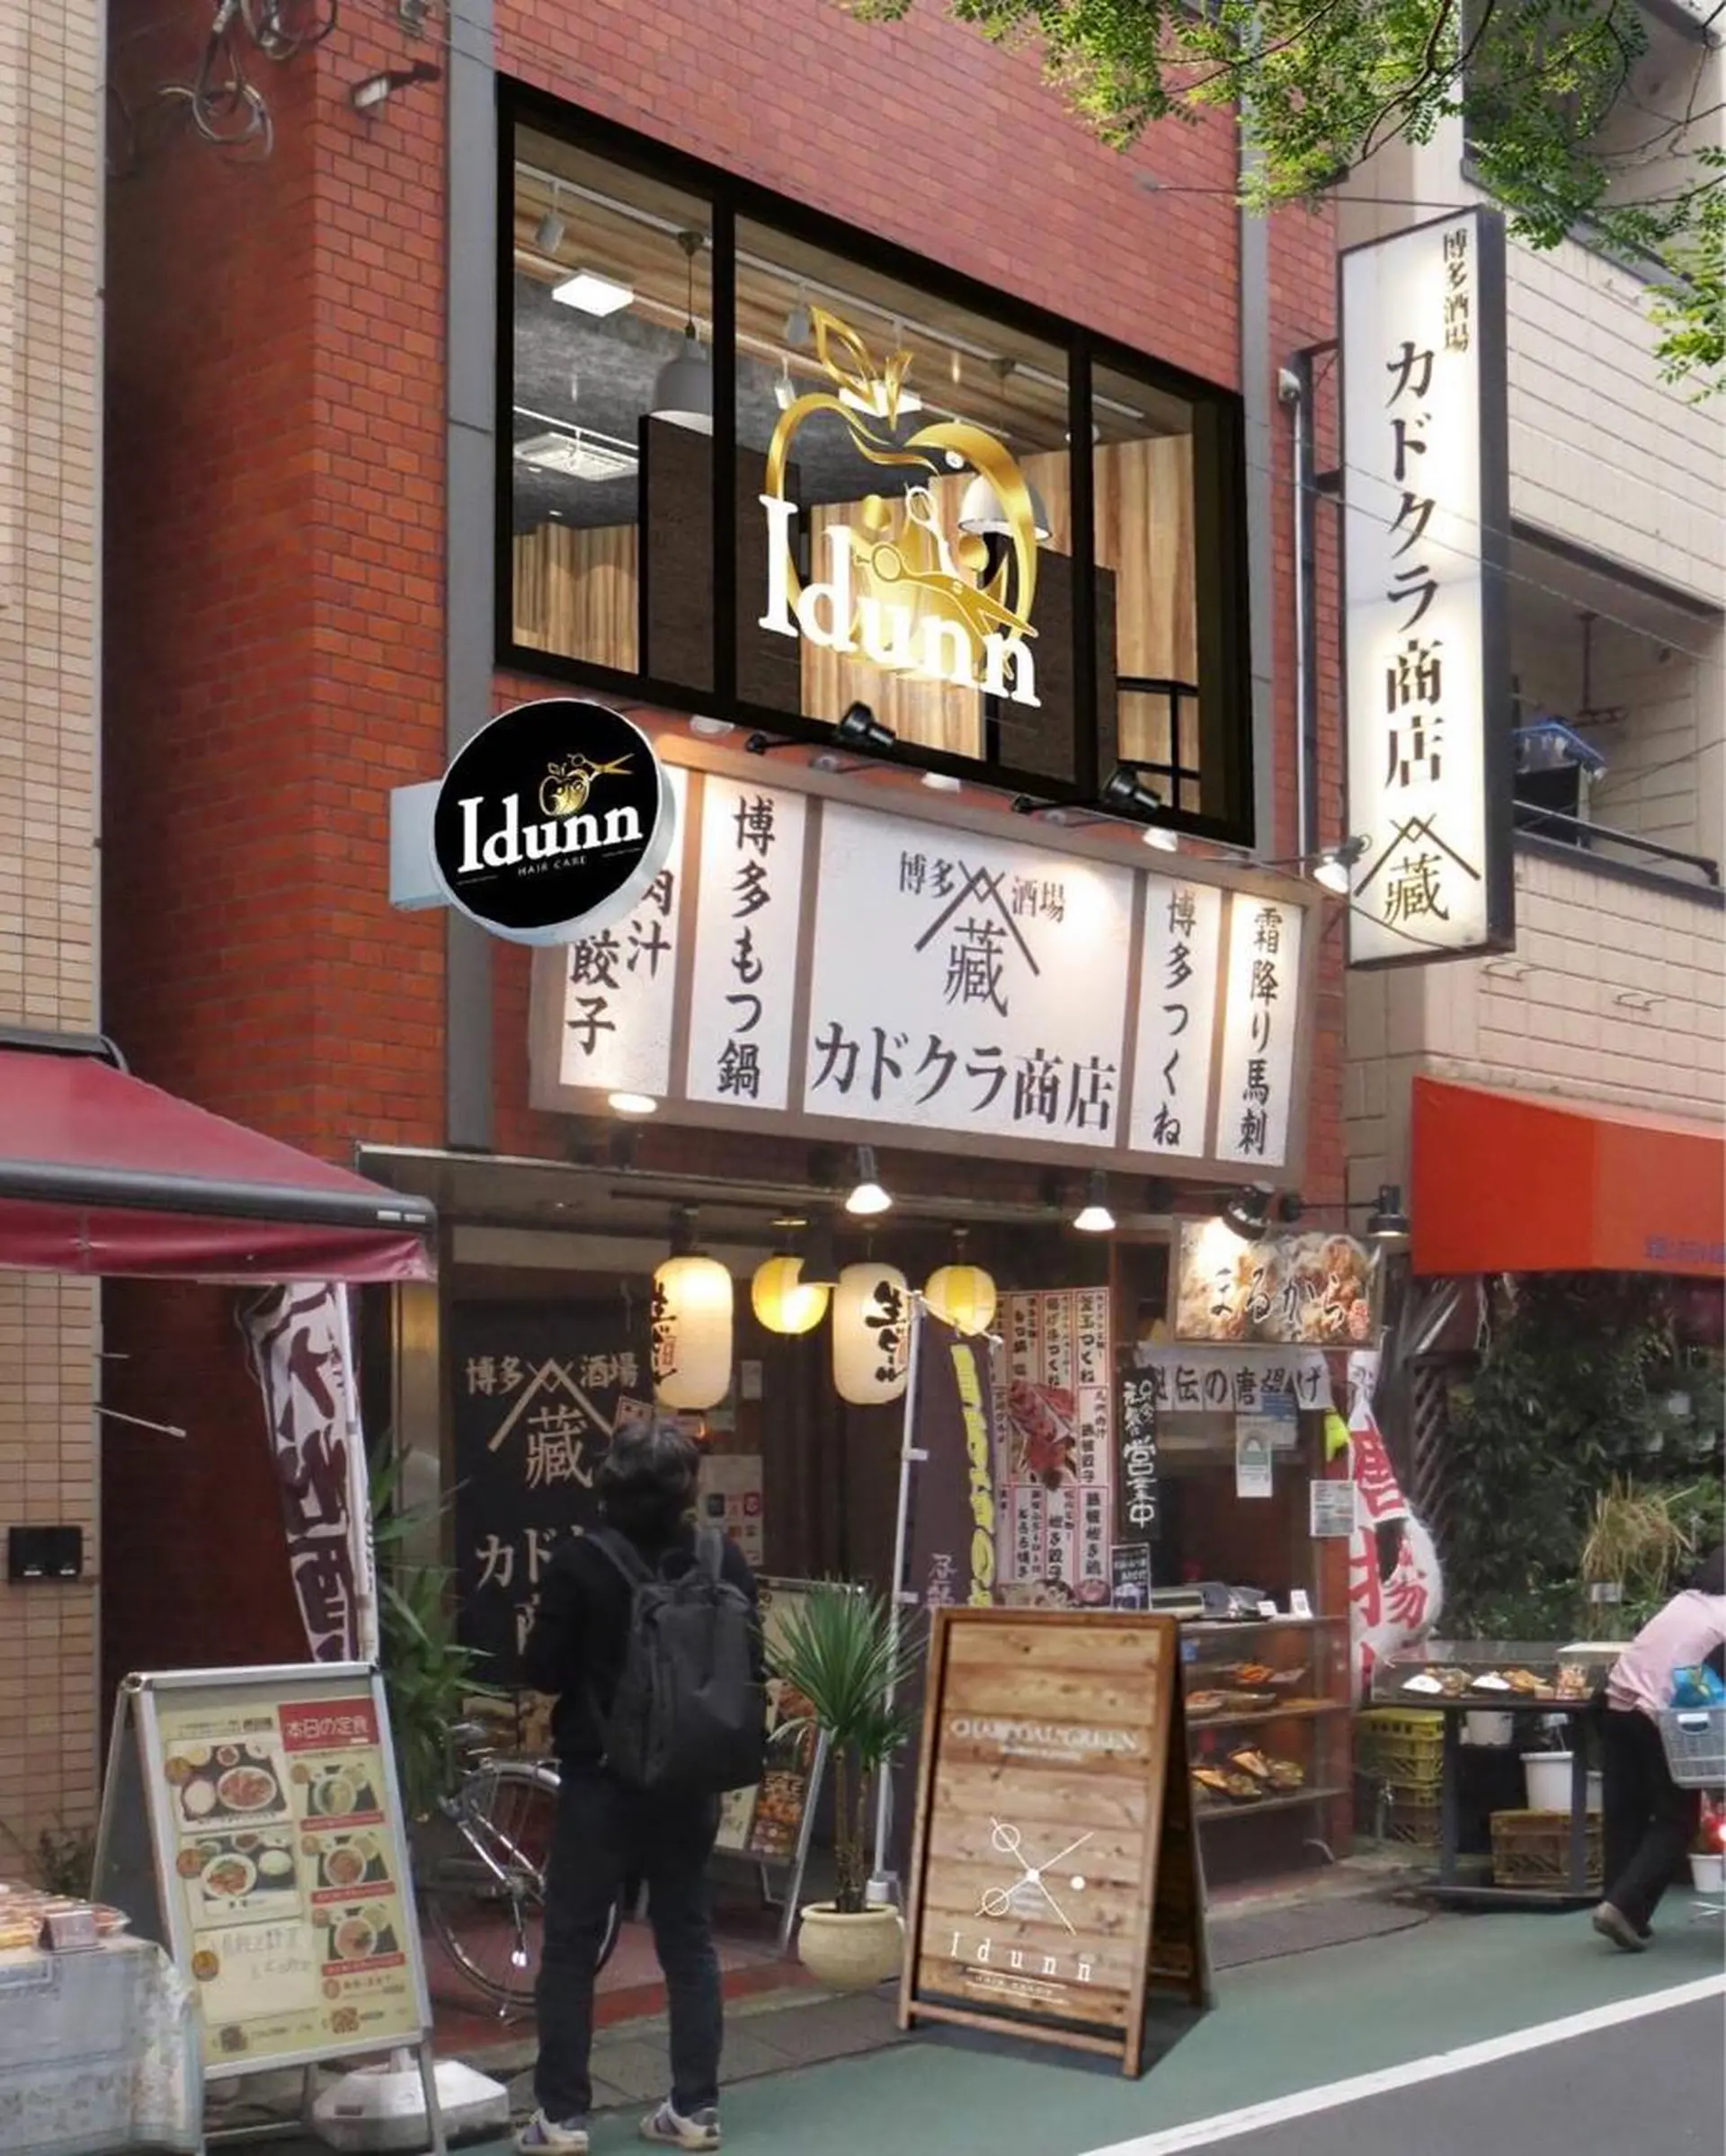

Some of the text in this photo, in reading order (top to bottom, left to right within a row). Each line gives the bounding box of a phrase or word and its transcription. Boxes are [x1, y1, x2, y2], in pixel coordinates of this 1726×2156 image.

[1443, 227, 1470, 353] 博多酒場
[759, 494, 1041, 707] Idunn
[1385, 341, 1446, 790] カドクラ商店
[458, 793, 643, 874] Idunn
[517, 855, 587, 877] HAIR CARE
[900, 849, 1066, 925] 博多 酒場
[567, 927, 620, 1055] 餃子
[716, 794, 777, 1099] 博多もつ鍋
[813, 1022, 1117, 1131] カドクラ商店
[1152, 890, 1197, 1148] 博多つくね
[1239, 907, 1284, 1156] 霜降り馬刺
[466, 1354, 524, 1395] 博多
[580, 1352, 639, 1389] 酒場
[476, 1525, 583, 1593] カド
